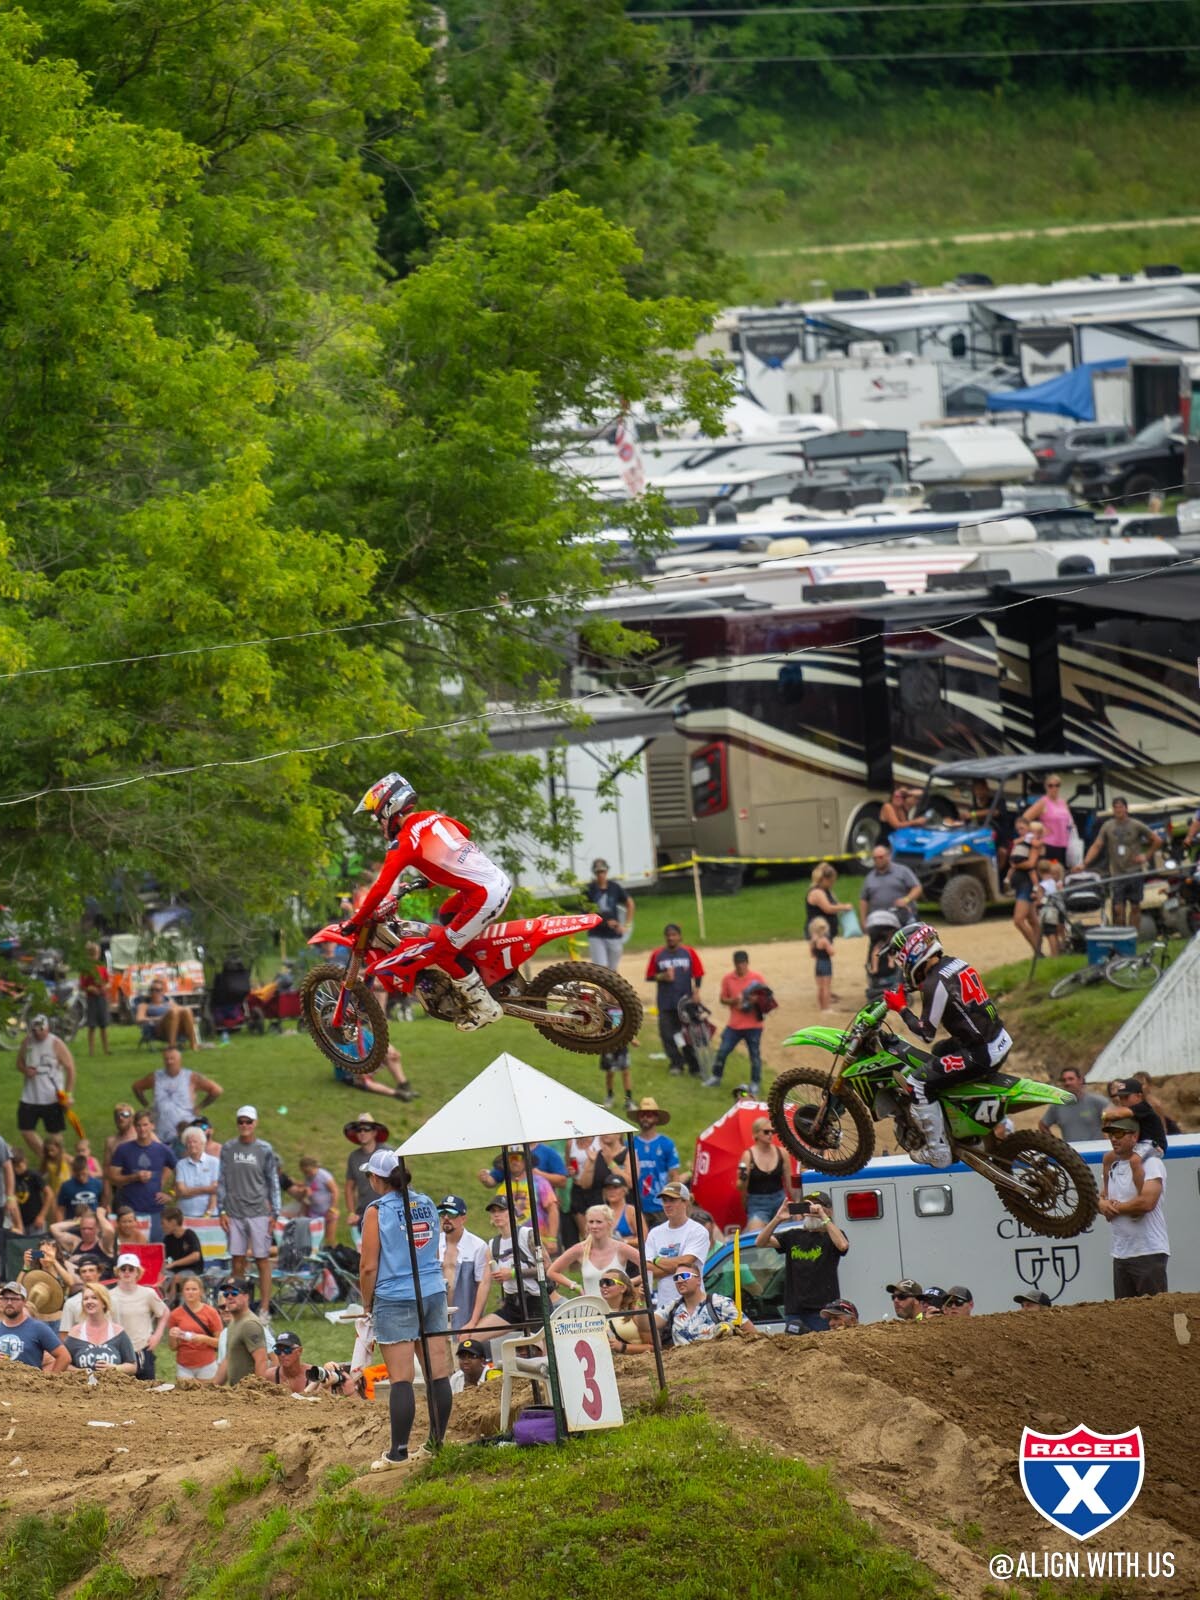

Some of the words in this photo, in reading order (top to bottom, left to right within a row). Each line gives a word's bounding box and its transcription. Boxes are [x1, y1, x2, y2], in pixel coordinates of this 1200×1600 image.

[431, 820, 461, 851] 1
[492, 935, 524, 946] HONDA
[501, 945, 514, 970] 1
[958, 967, 988, 1005] 47
[975, 1100, 1000, 1122] 47
[397, 1206, 433, 1221] FGGER
[560, 1322, 582, 1330] Spring
[585, 1319, 604, 1327] Creek
[574, 1340, 602, 1421] 3
